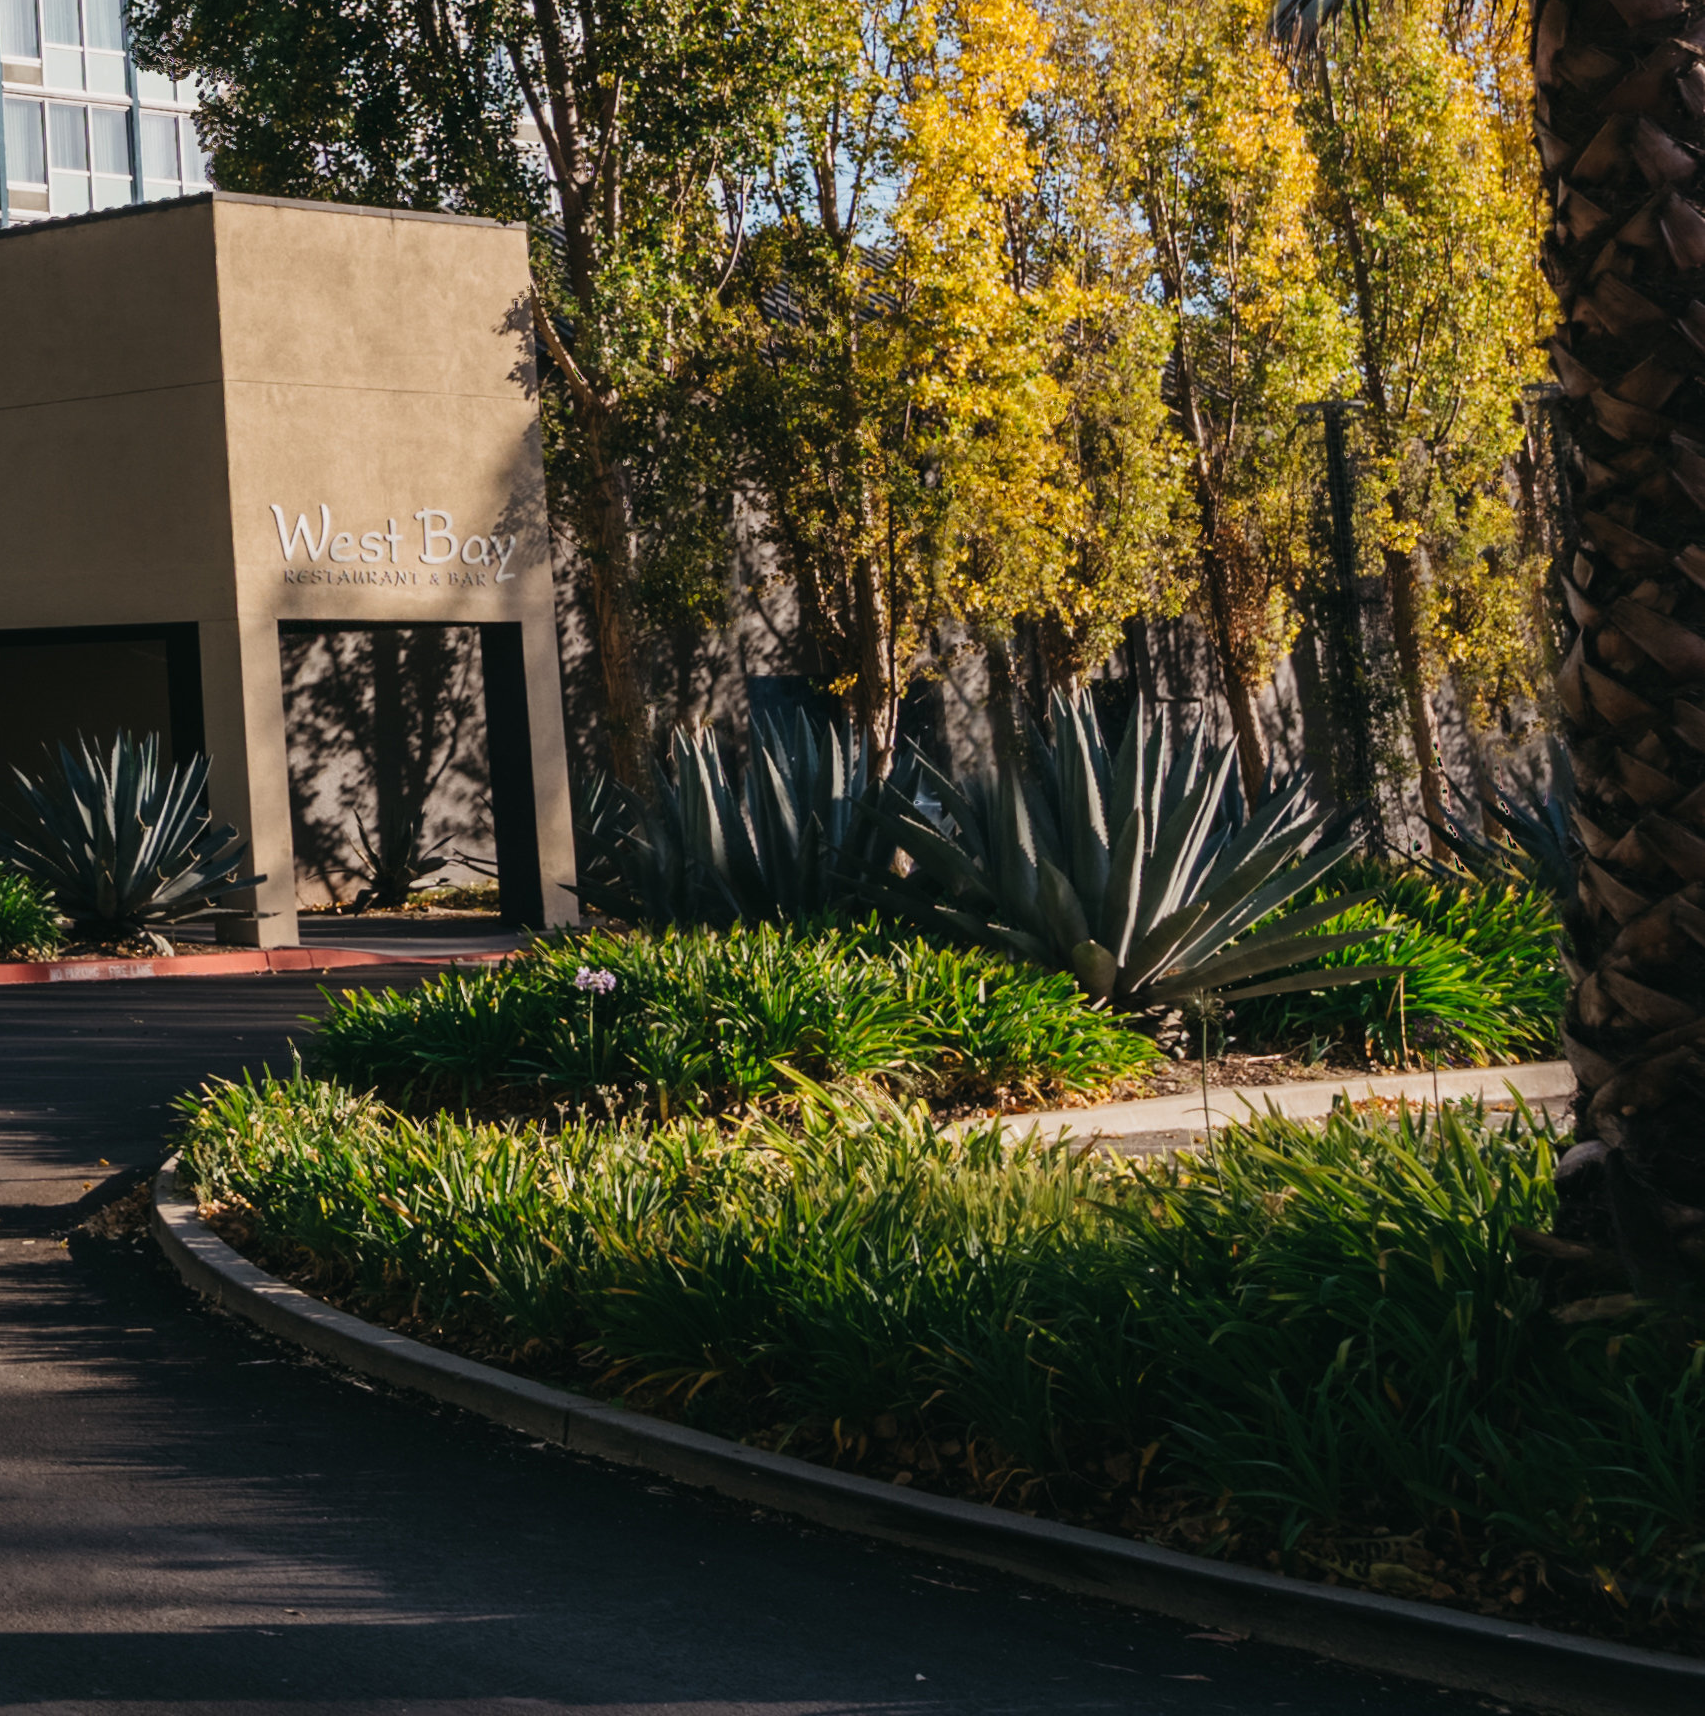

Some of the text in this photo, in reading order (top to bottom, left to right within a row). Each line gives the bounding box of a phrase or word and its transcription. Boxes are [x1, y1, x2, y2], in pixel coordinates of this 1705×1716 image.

[269, 503, 517, 583] West Bay
[283, 568, 488, 586] RESTAURANT & BAR
